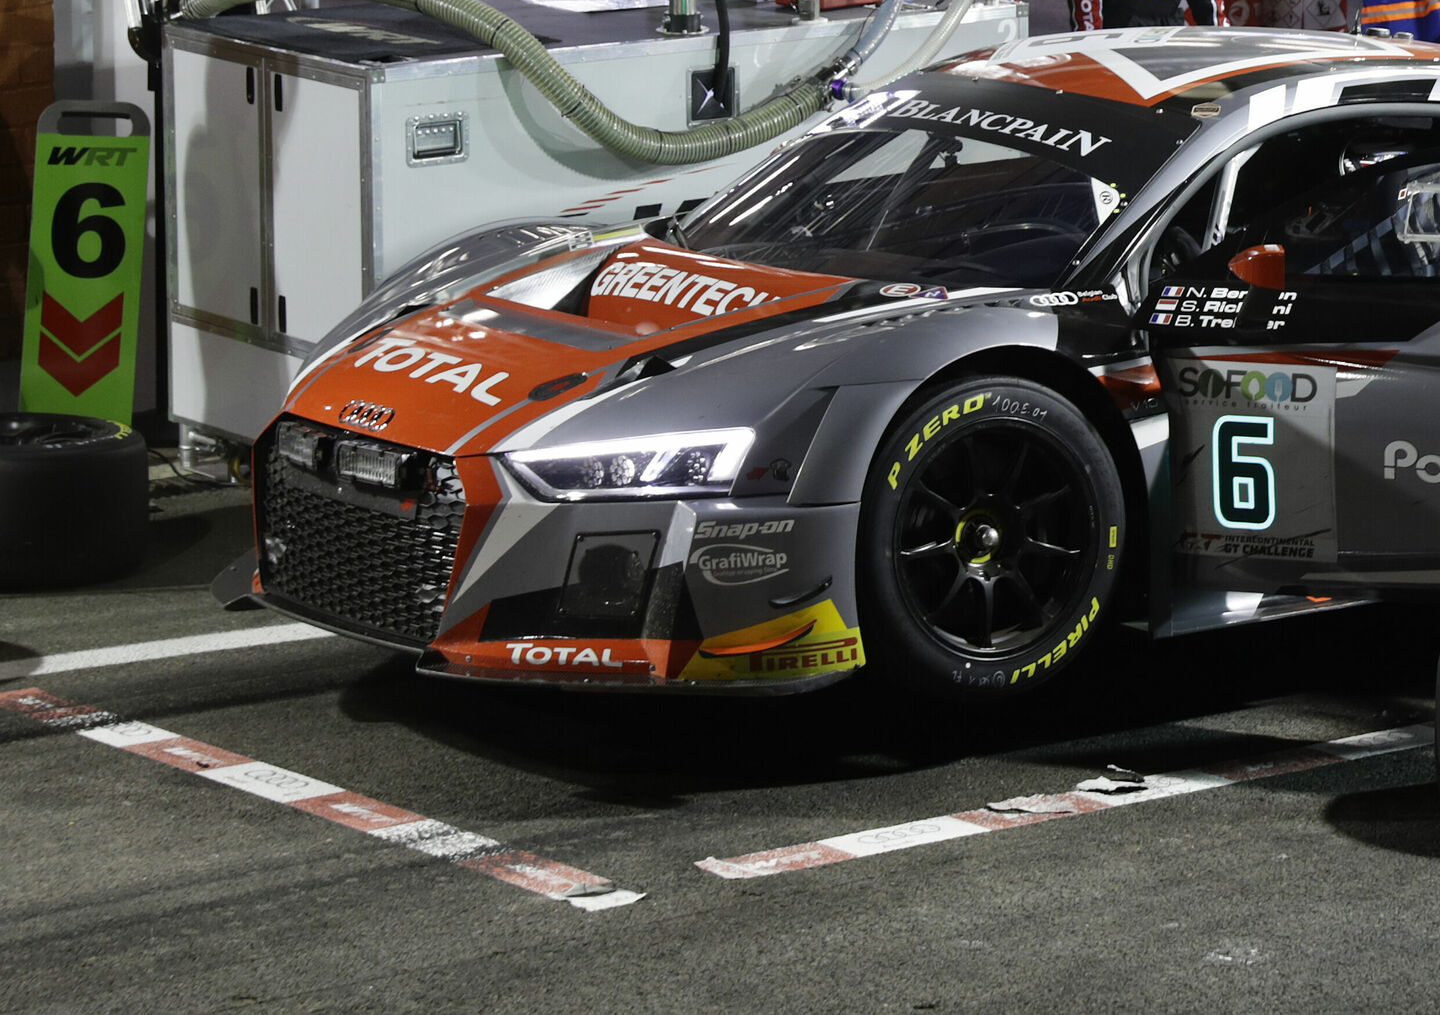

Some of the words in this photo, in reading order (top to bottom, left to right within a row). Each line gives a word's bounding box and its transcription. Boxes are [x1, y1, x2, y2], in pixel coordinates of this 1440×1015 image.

[887, 99, 1113, 157] BLANCPAIN
[47, 146, 138, 166] WRT
[51, 182, 126, 279] 6
[1101, 293, 1117, 301] Club
[1186, 286, 1207, 298] N.
[1180, 300, 1200, 312] S.
[1174, 314, 1195, 327] B.
[354, 338, 510, 407] TOTAL
[1184, 398, 1237, 408] service
[1246, 401, 1307, 412] traiteur
[887, 462, 901, 490] P
[904, 393, 985, 462] ZERO
[1211, 414, 1276, 531] 6
[694, 519, 795, 540] Snap-on
[1224, 535, 1315, 547] INTERCONTINENTAL
[1224, 543, 1240, 553] GT
[1243, 544, 1315, 558] CHALLENGE
[699, 551, 788, 571] GrafiWrap
[1009, 597, 1101, 685] PIRELLI
[506, 642, 623, 668] TOTAL
[750, 636, 858, 672] PIRELLI
